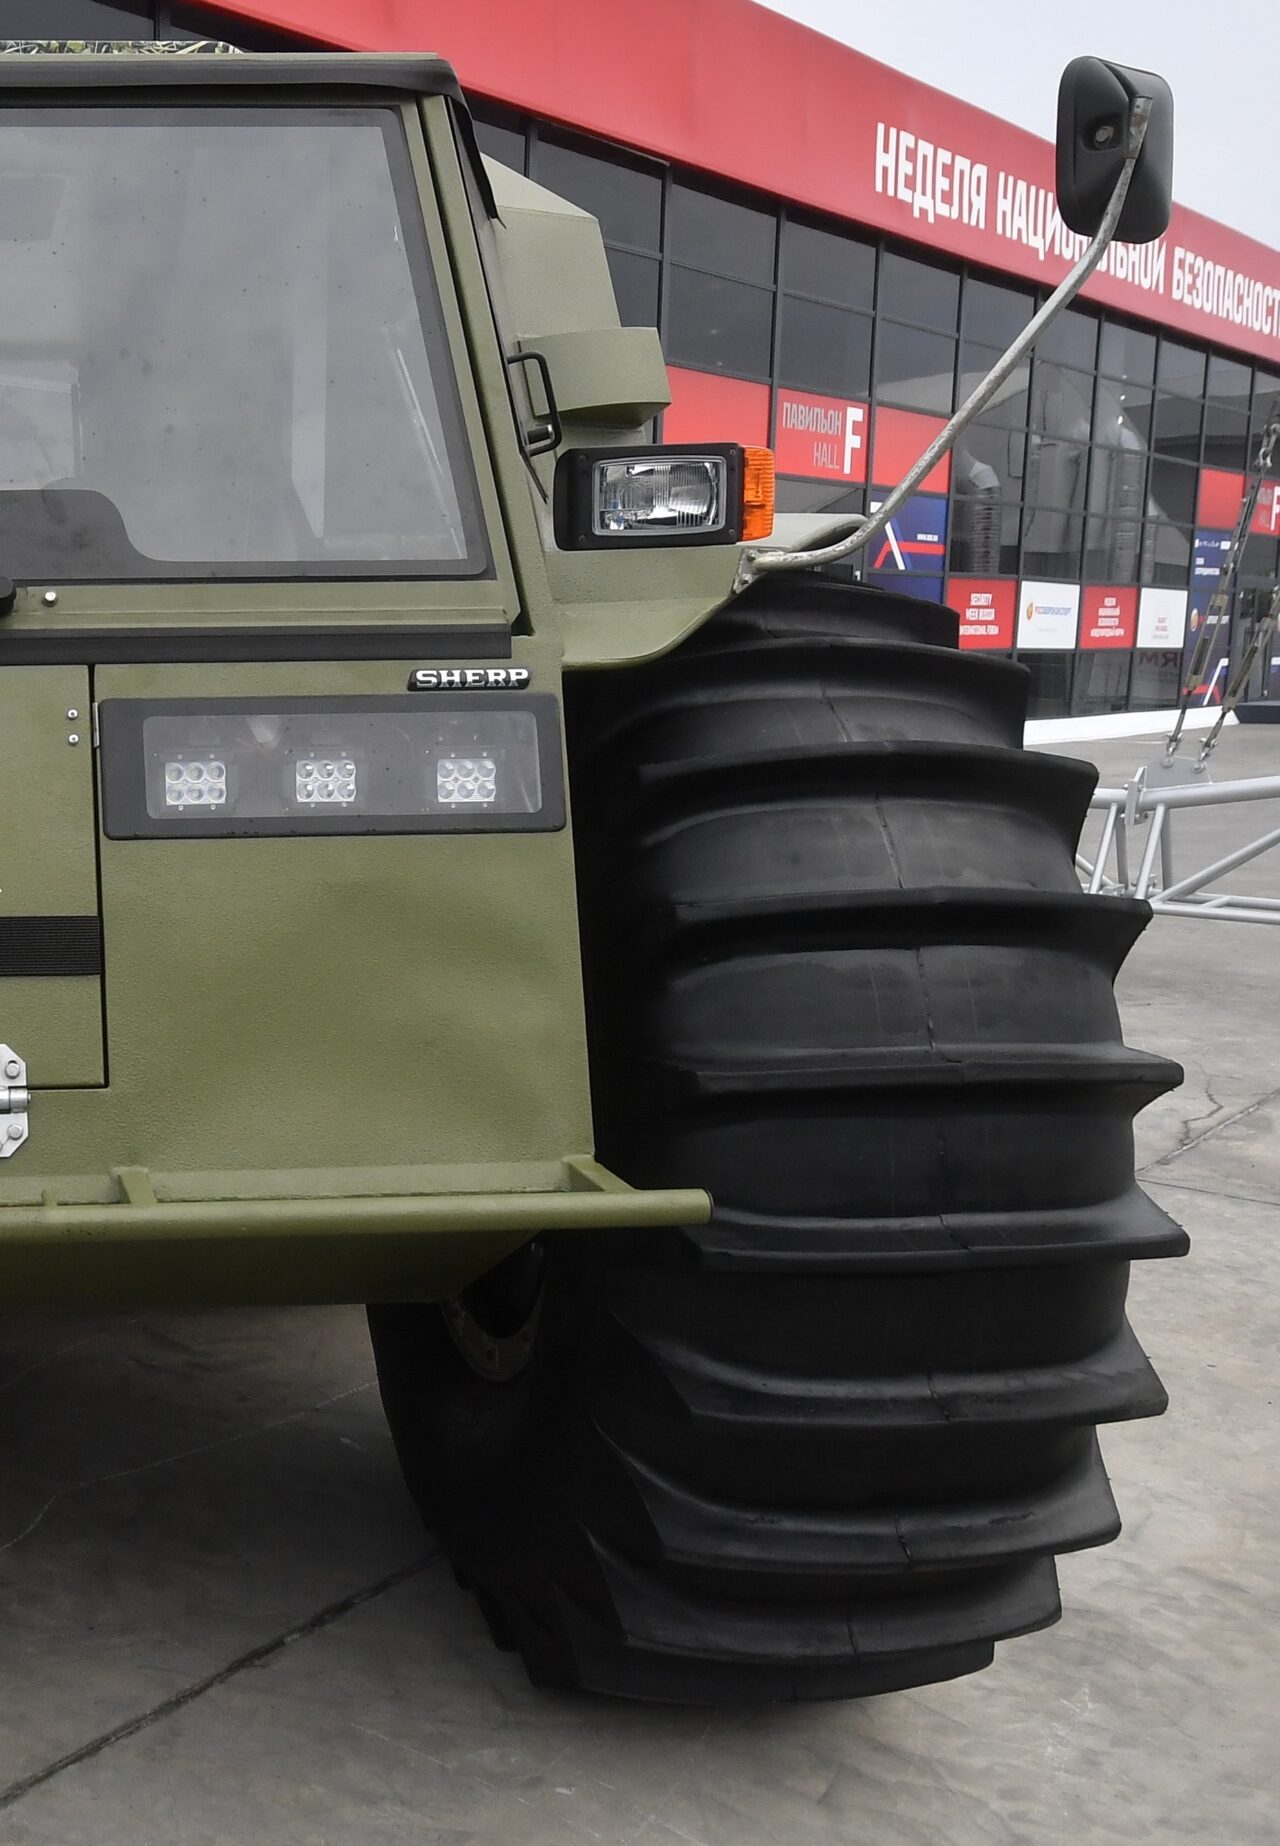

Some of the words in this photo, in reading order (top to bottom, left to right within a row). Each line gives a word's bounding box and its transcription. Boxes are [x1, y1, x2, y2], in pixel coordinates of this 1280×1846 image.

[875, 122, 987, 229] НЕДЕЛЯ
[1172, 246, 1280, 339] БЕЗОПАСНОСТ
[782, 402, 842, 436] ПАВИЛЬОН
[843, 406, 864, 474] F
[813, 442, 839, 469] HALL
[415, 668, 529, 688] SHERP
